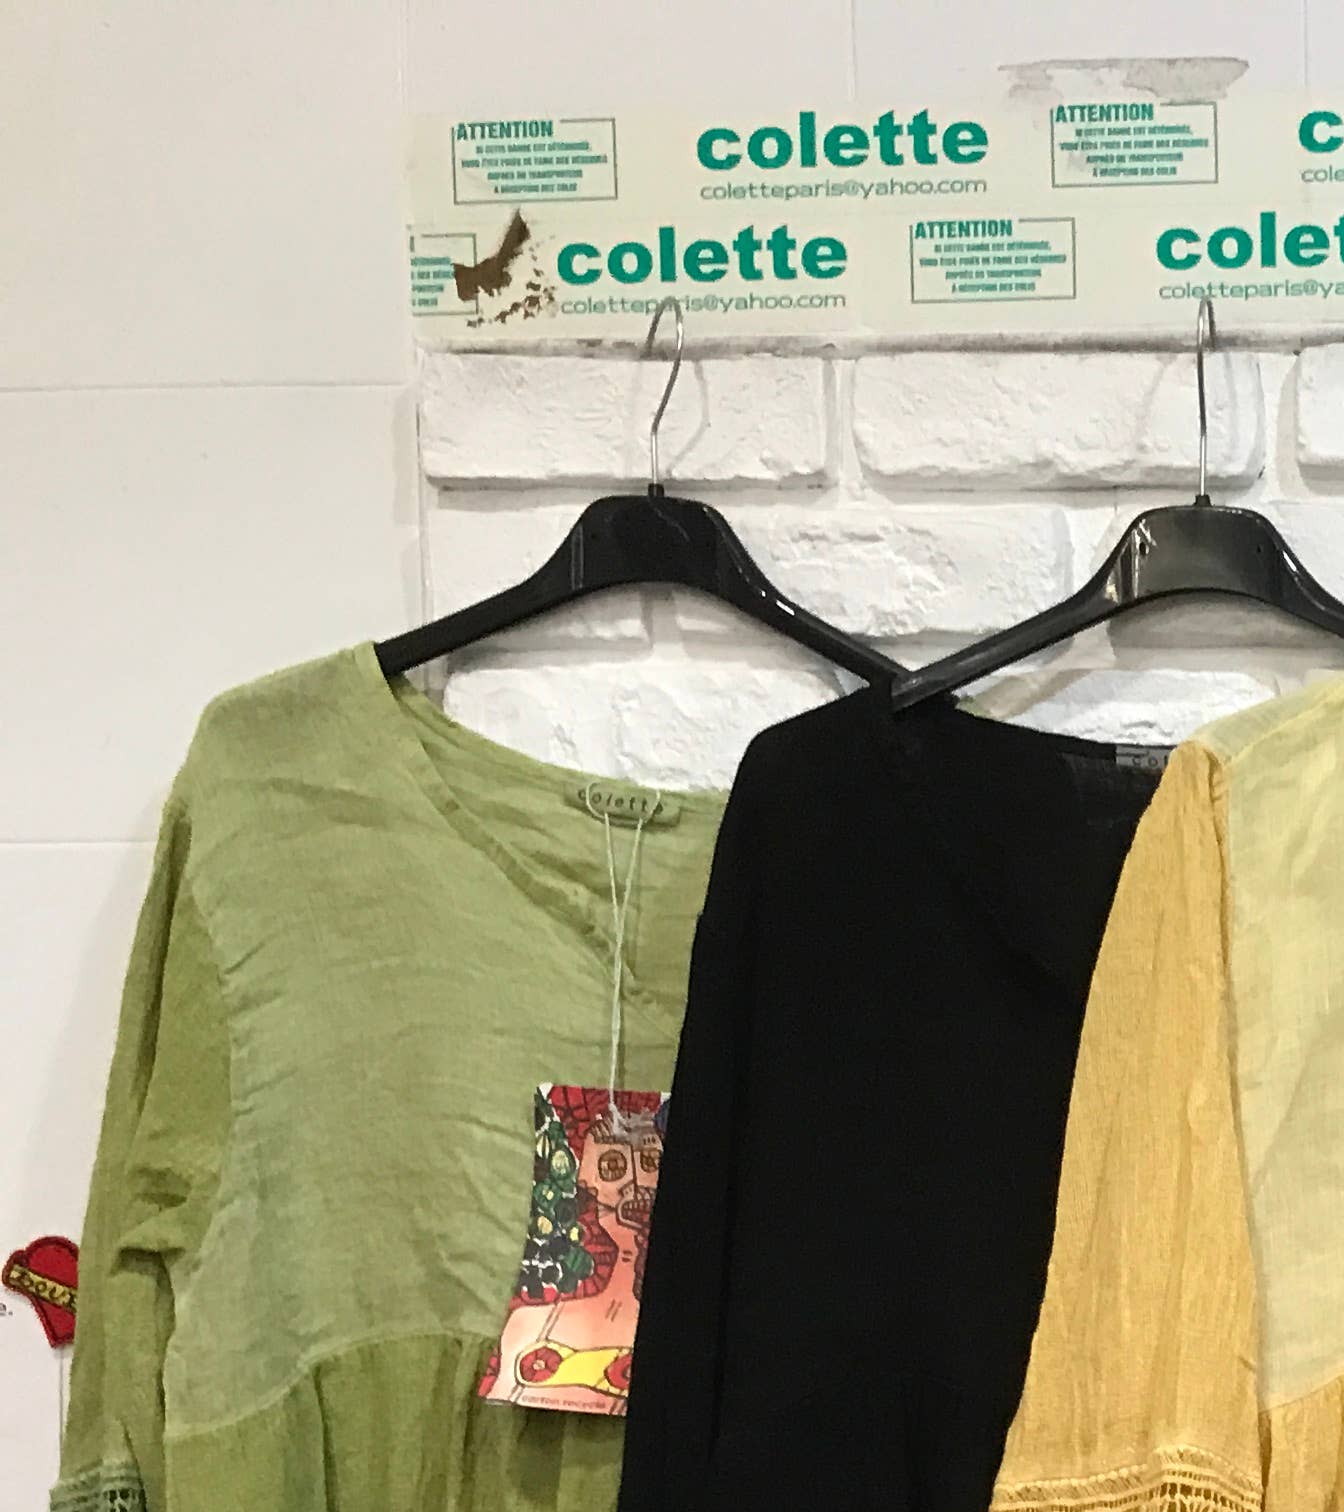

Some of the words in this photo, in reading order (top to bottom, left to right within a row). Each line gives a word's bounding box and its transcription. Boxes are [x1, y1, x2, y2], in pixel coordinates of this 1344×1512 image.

[1056, 103, 1154, 122] ATTENTION
[457, 120, 553, 140] ATTENTION
[698, 110, 988, 169] colette
[700, 178, 987, 200] coletteparis@yahoo.com
[915, 219, 1012, 239] ATTENTION
[557, 226, 847, 285] colette
